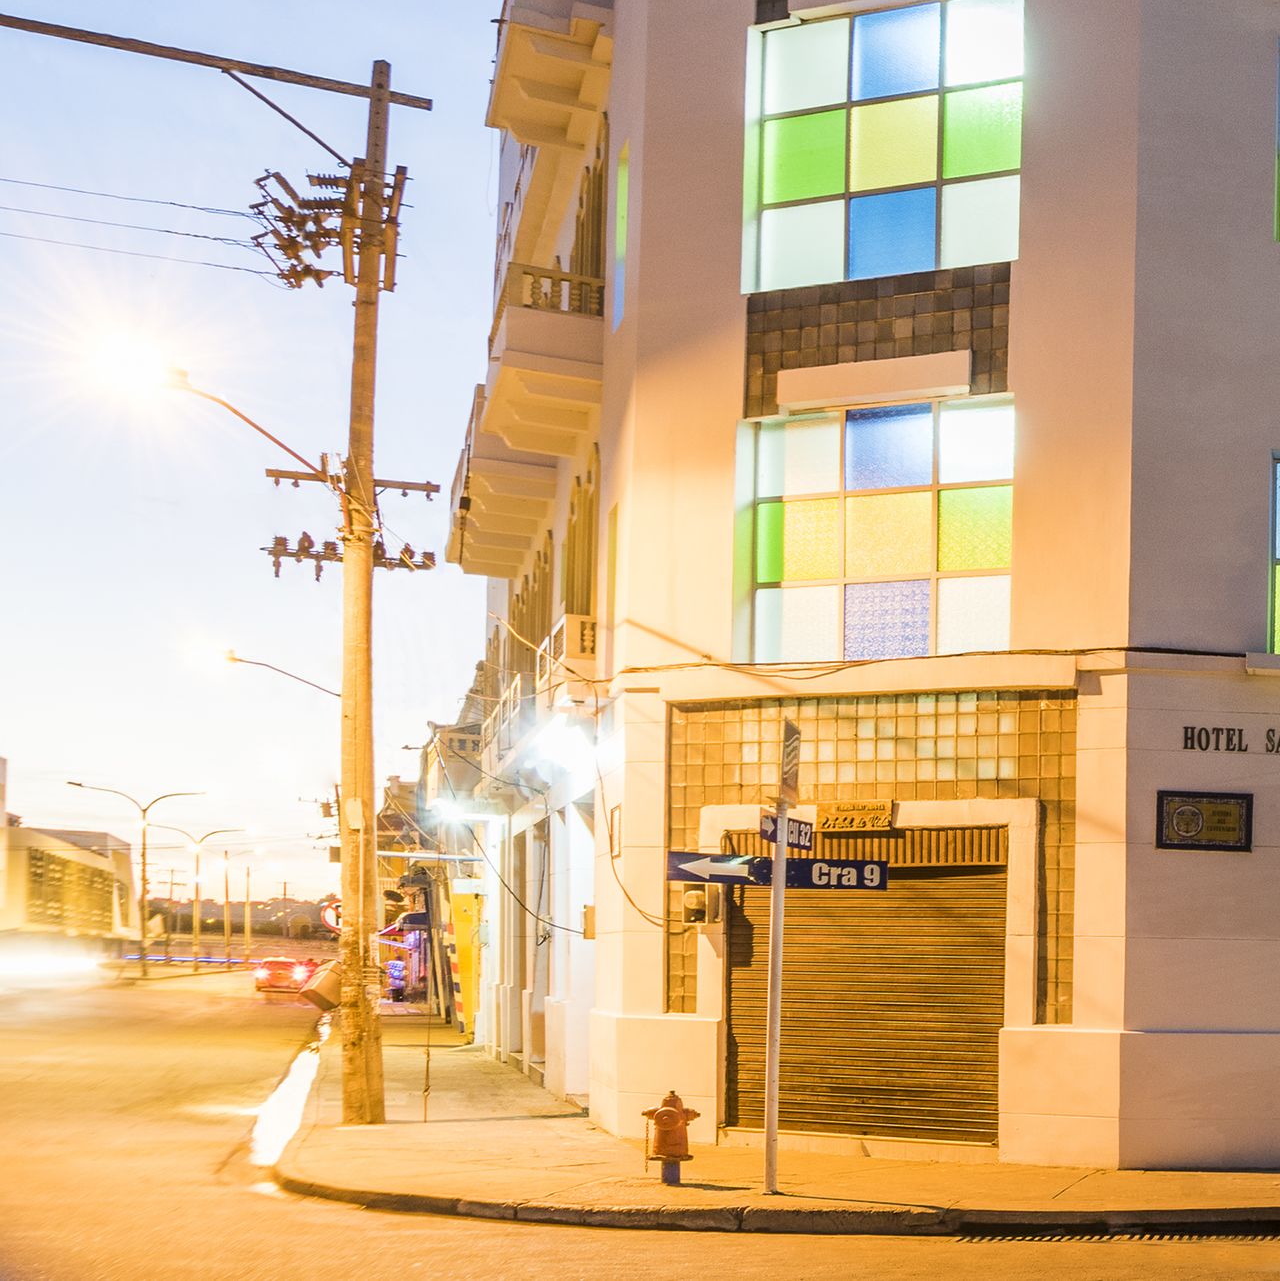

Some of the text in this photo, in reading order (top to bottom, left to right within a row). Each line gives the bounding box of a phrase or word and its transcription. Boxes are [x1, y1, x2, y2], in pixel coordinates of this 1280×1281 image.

[1182, 726, 1248, 753] HOTEL
[799, 824, 811, 846] 32
[812, 862, 881, 887] Cra 9
